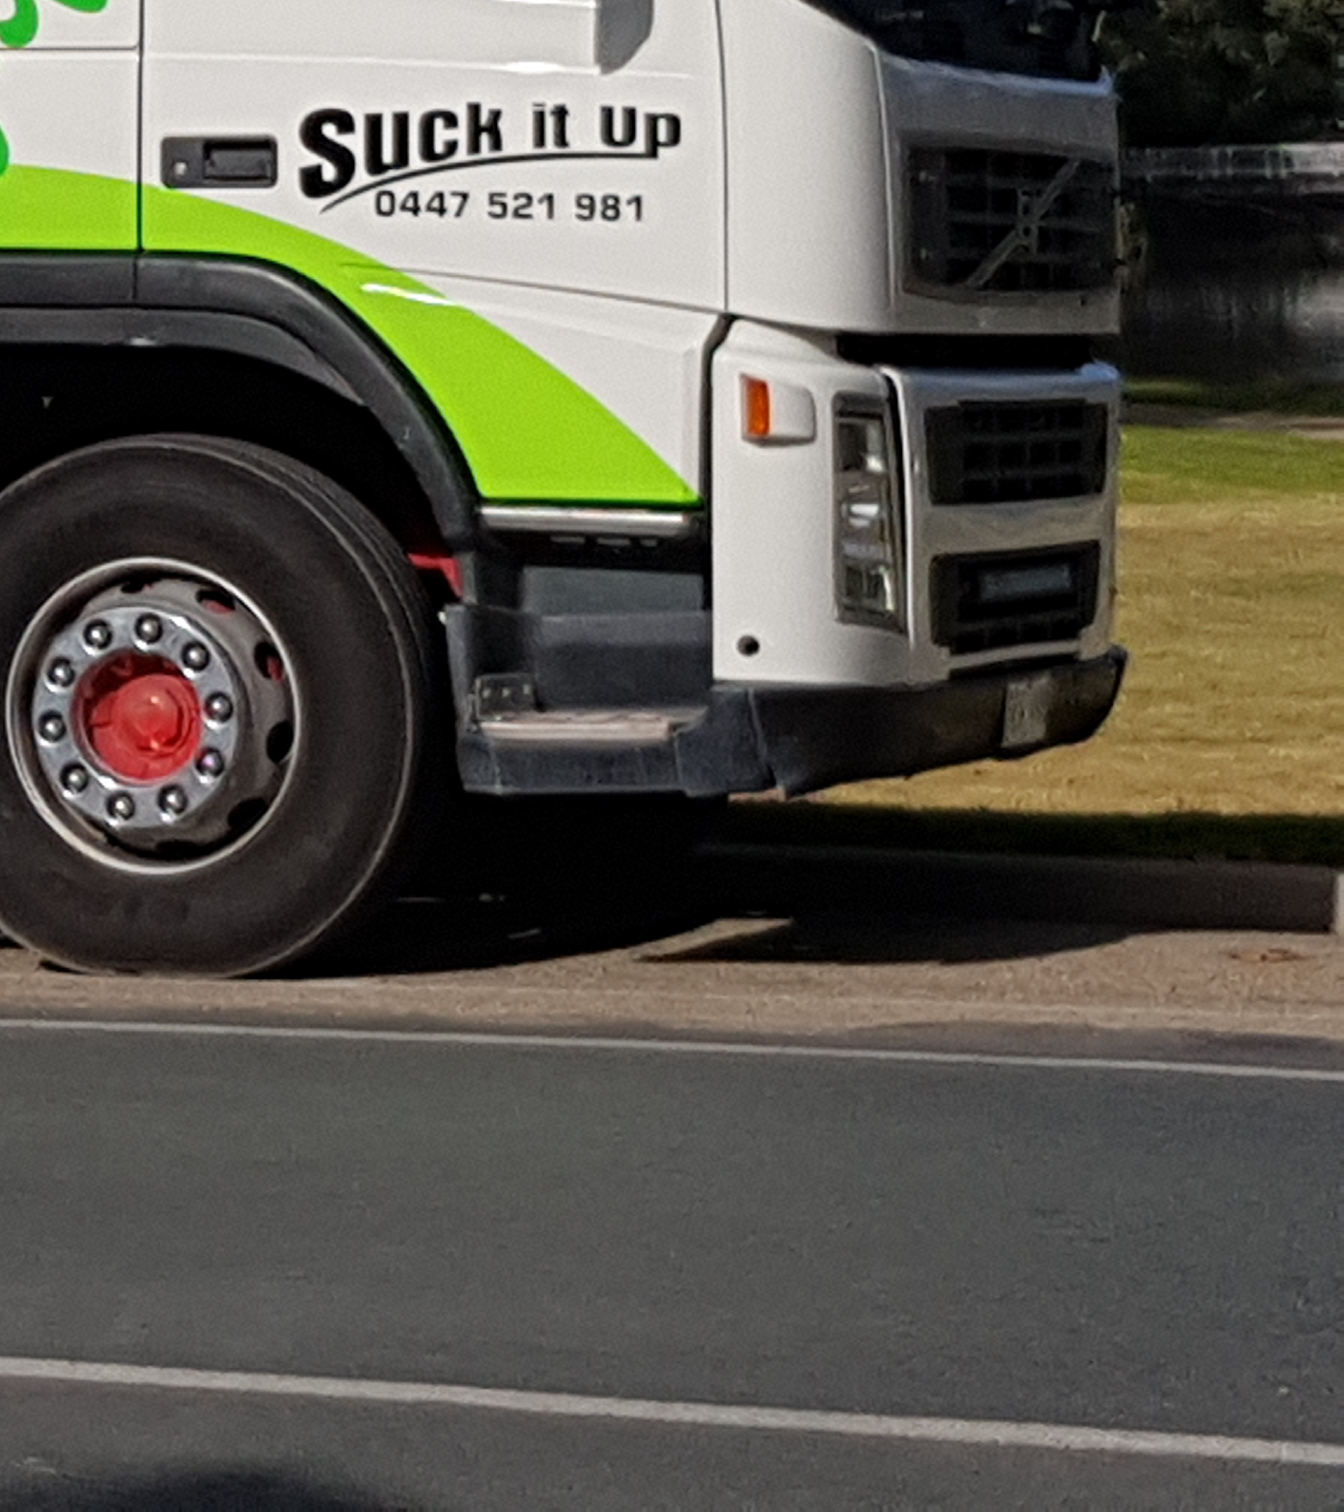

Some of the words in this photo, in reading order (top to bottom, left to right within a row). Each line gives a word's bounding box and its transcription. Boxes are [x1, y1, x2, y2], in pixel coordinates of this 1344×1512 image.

[299, 102, 503, 199] Suck
[531, 103, 569, 149] it
[600, 106, 681, 157] Up
[375, 190, 469, 217] 0447
[488, 192, 554, 219] 521
[576, 194, 643, 221] 981
